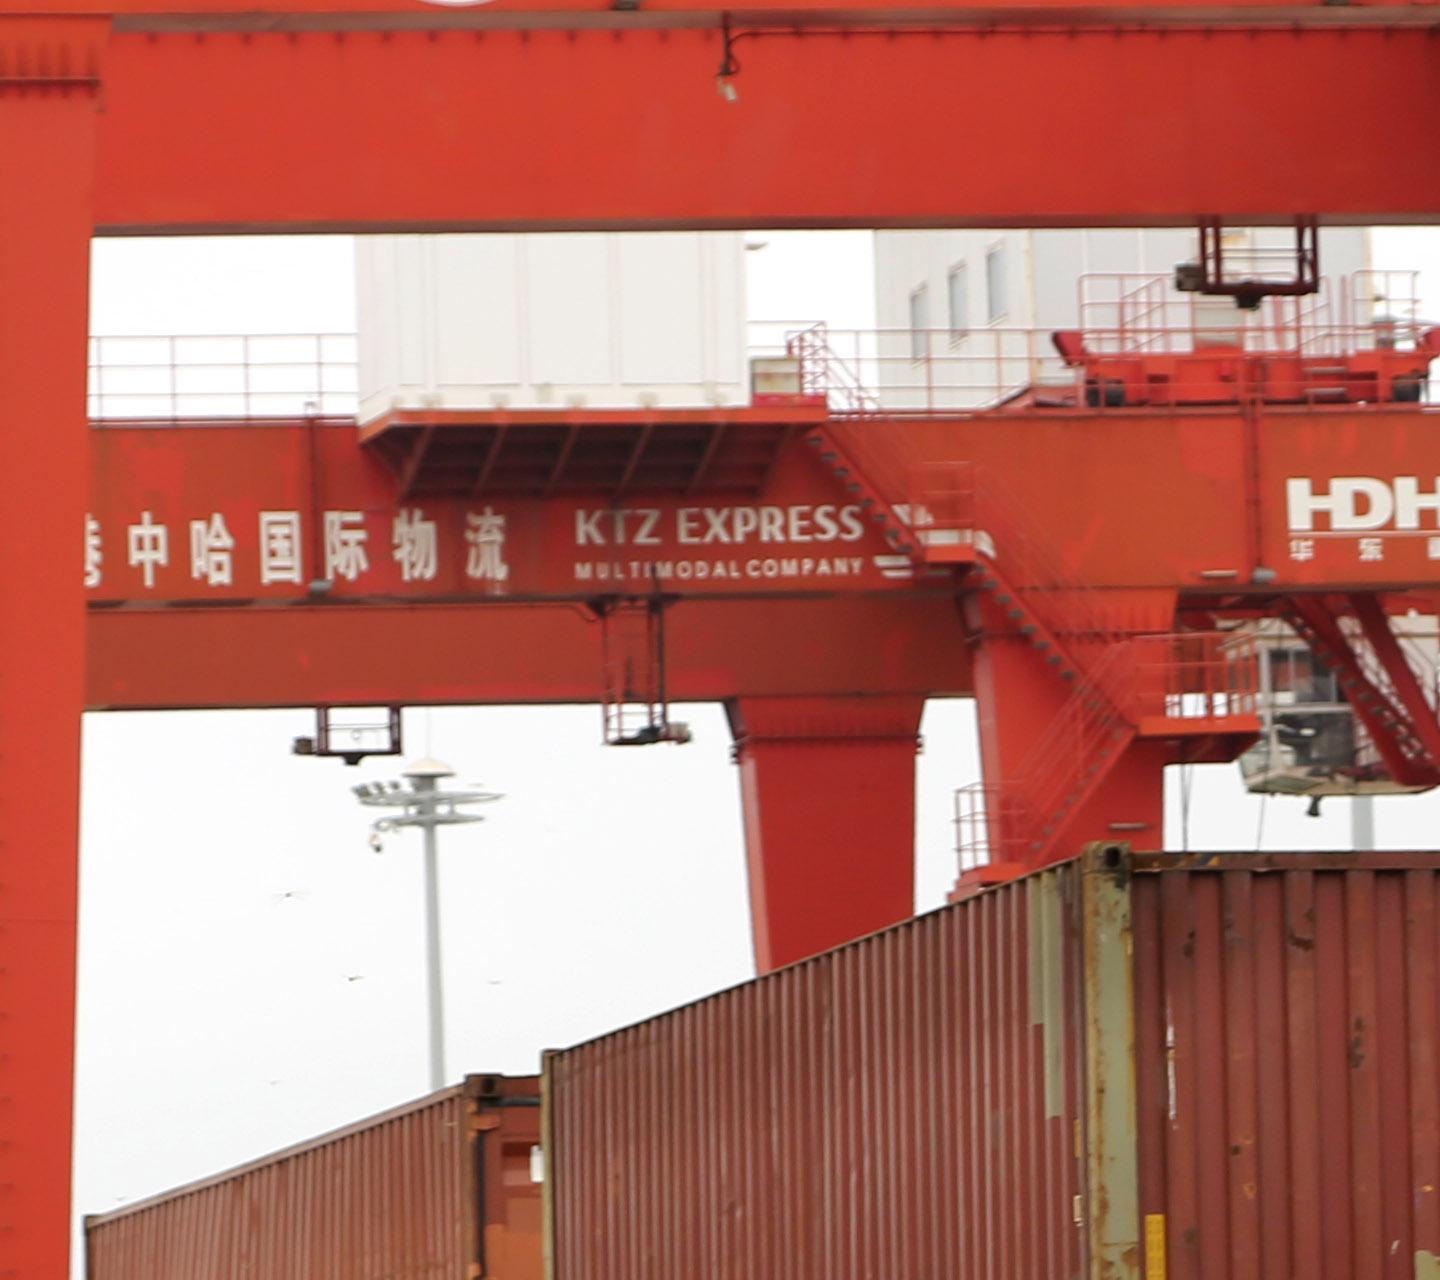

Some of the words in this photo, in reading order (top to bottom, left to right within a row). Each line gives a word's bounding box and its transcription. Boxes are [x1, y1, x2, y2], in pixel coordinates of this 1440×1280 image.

[574, 507, 662, 547] KTZ
[678, 503, 864, 546] EXPRESS
[746, 555, 864, 580] COMPANY
